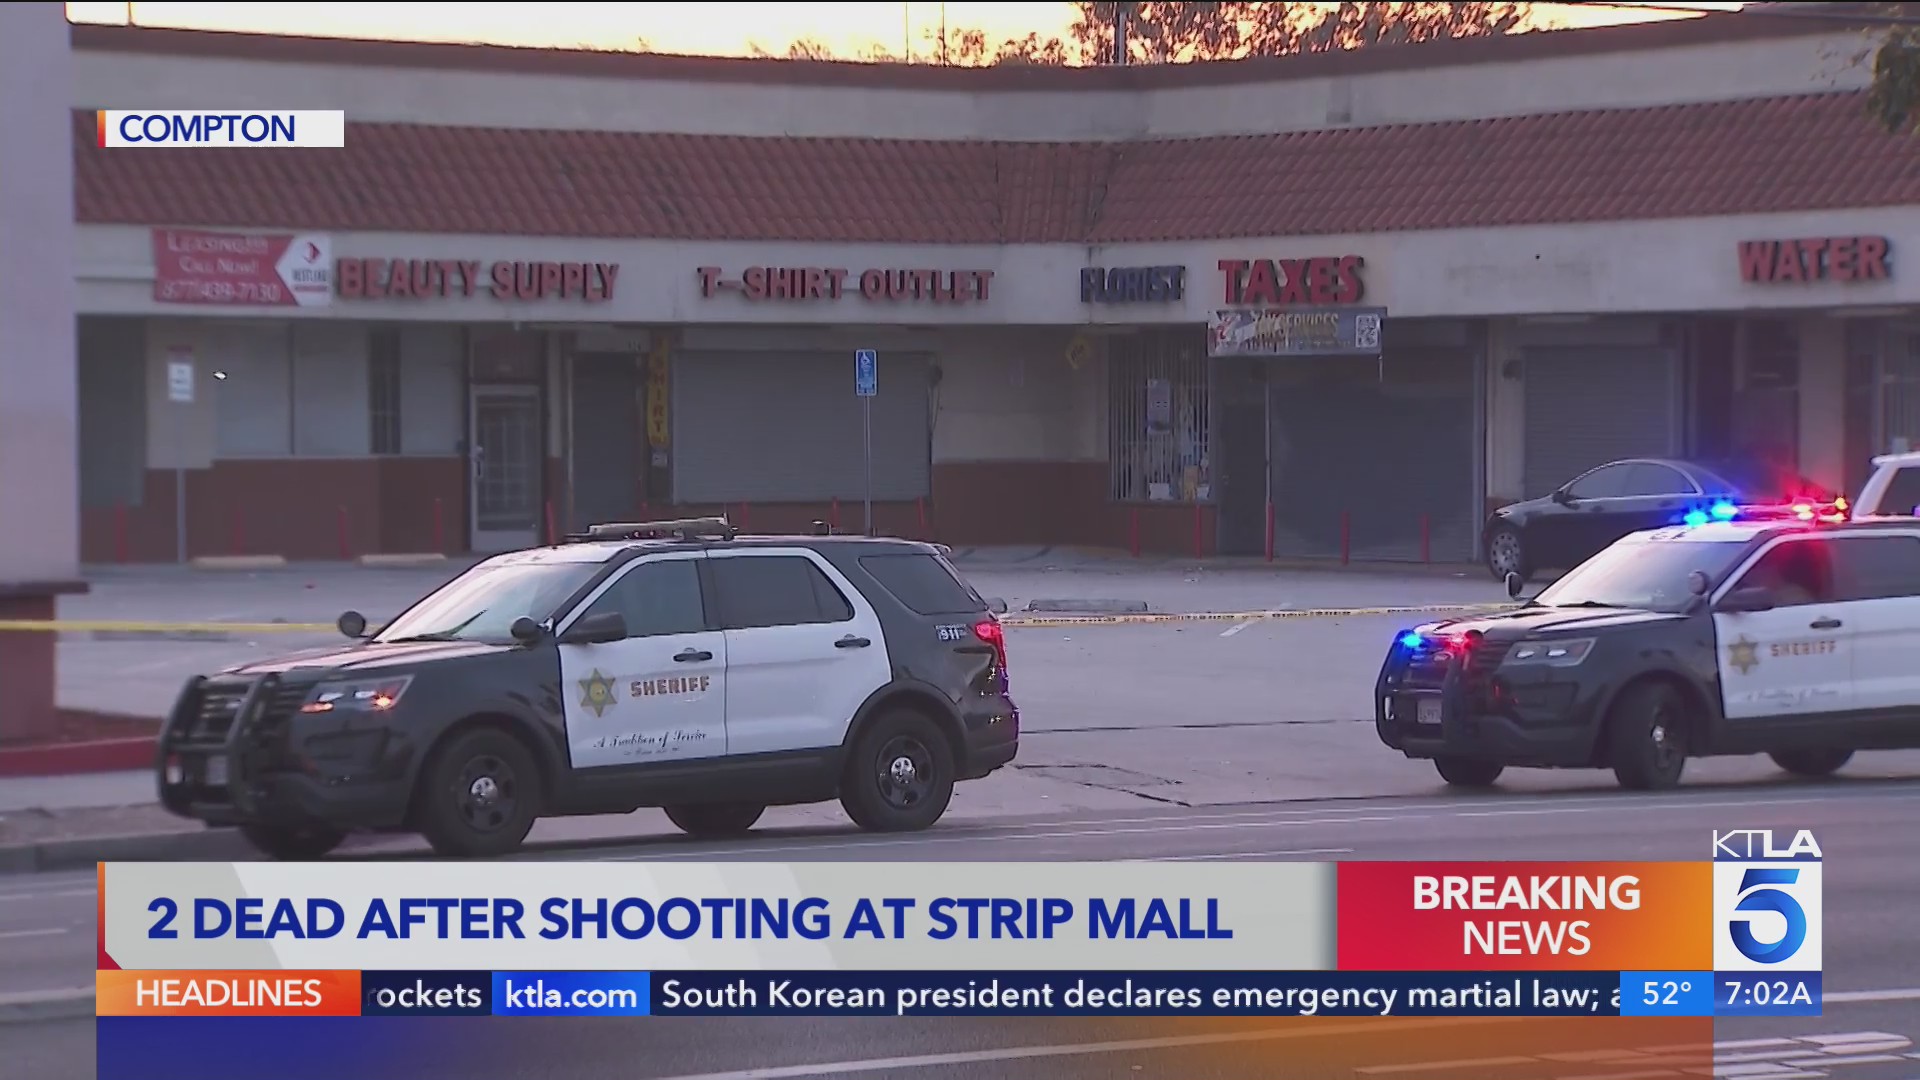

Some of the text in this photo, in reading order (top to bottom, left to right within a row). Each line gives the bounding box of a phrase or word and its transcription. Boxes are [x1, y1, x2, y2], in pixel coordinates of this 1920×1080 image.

[1737, 236, 1893, 283] WATER
[337, 257, 619, 300] BEAUTY SUPPLY
[697, 266, 995, 300] T-SHIRT OUTLET
[1080, 265, 1186, 302] FLORIST
[1217, 255, 1364, 305] TAXES
[1770, 640, 1836, 657] SHERIFF
[630, 675, 711, 698] SHERIFF
